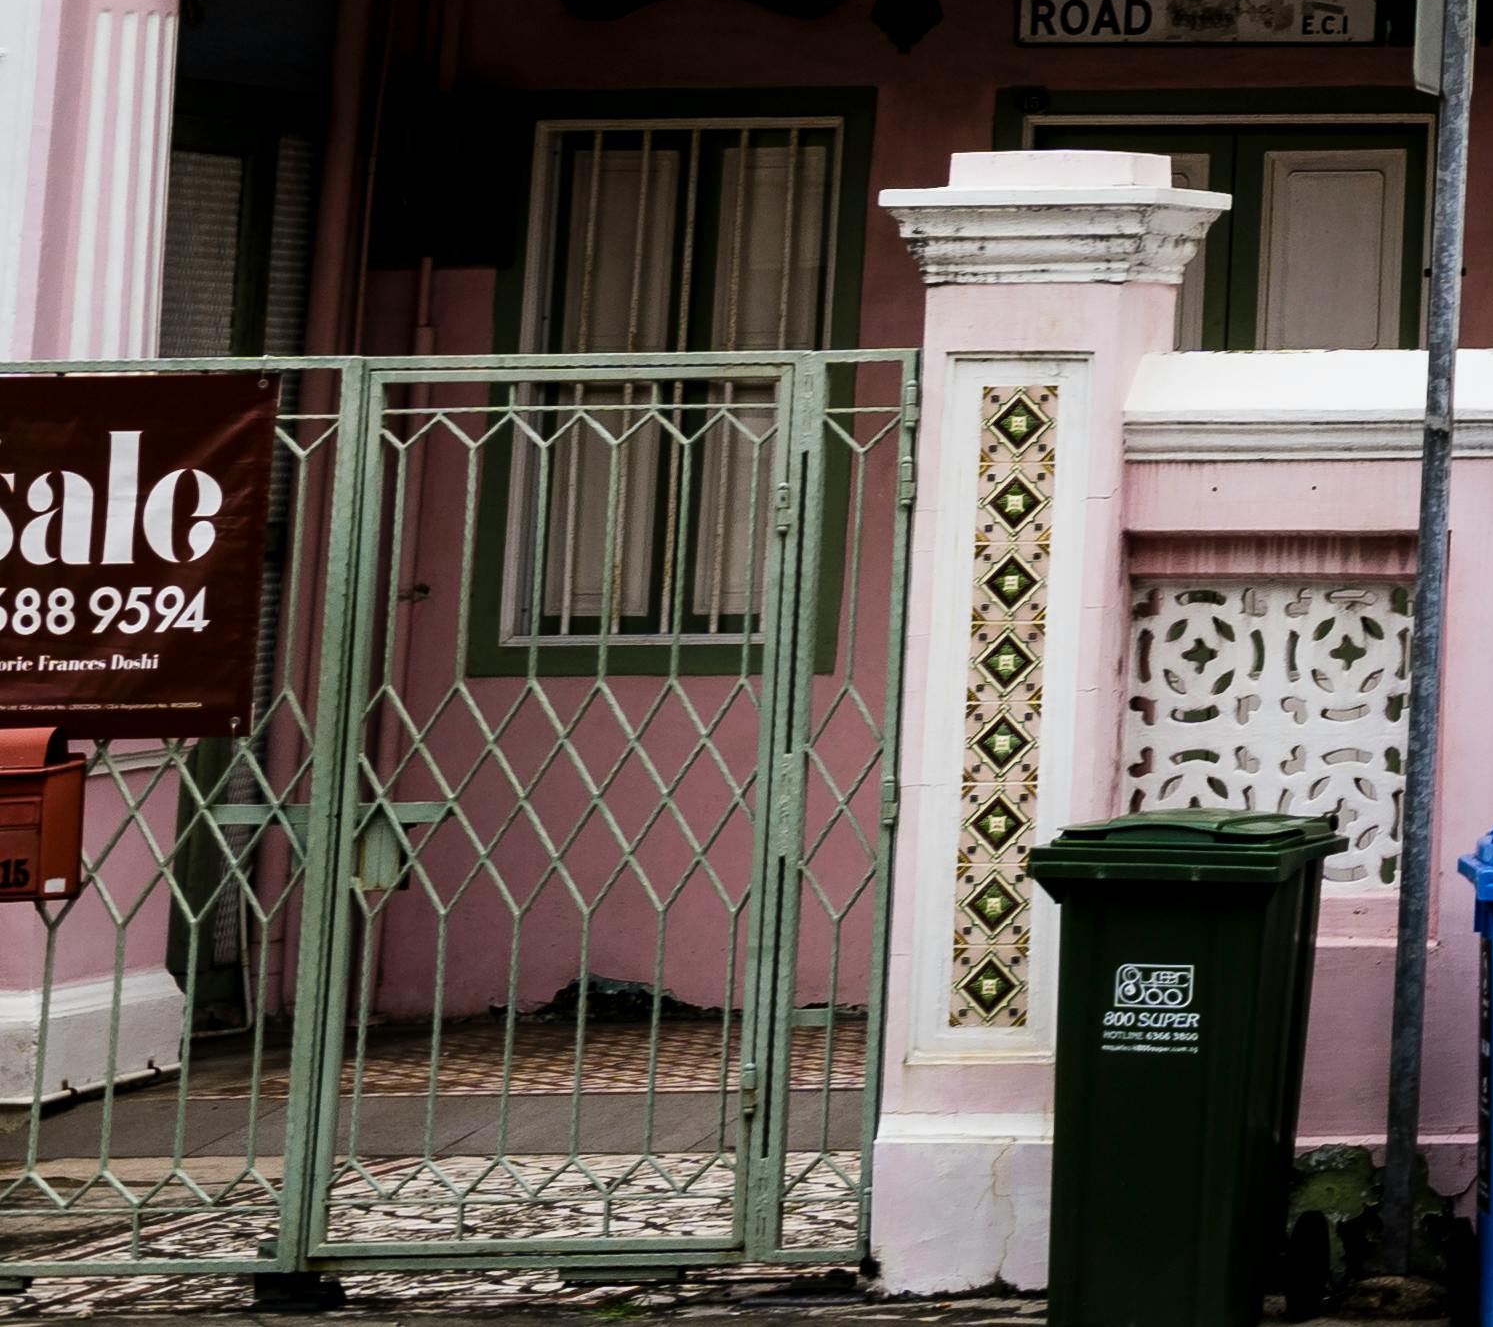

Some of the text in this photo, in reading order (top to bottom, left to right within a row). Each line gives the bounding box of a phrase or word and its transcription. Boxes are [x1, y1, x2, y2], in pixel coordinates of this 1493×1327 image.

[89, 585, 212, 635] 9594
[38, 654, 107, 672] Frances
[110, 653, 160, 670] Doshi
[0, 859, 29, 888] 15
[1103, 1011, 1201, 1028] 800 SUPER
[1103, 1030, 1145, 1040] HOTLINE
[1145, 1032, 1172, 1041] 6366
